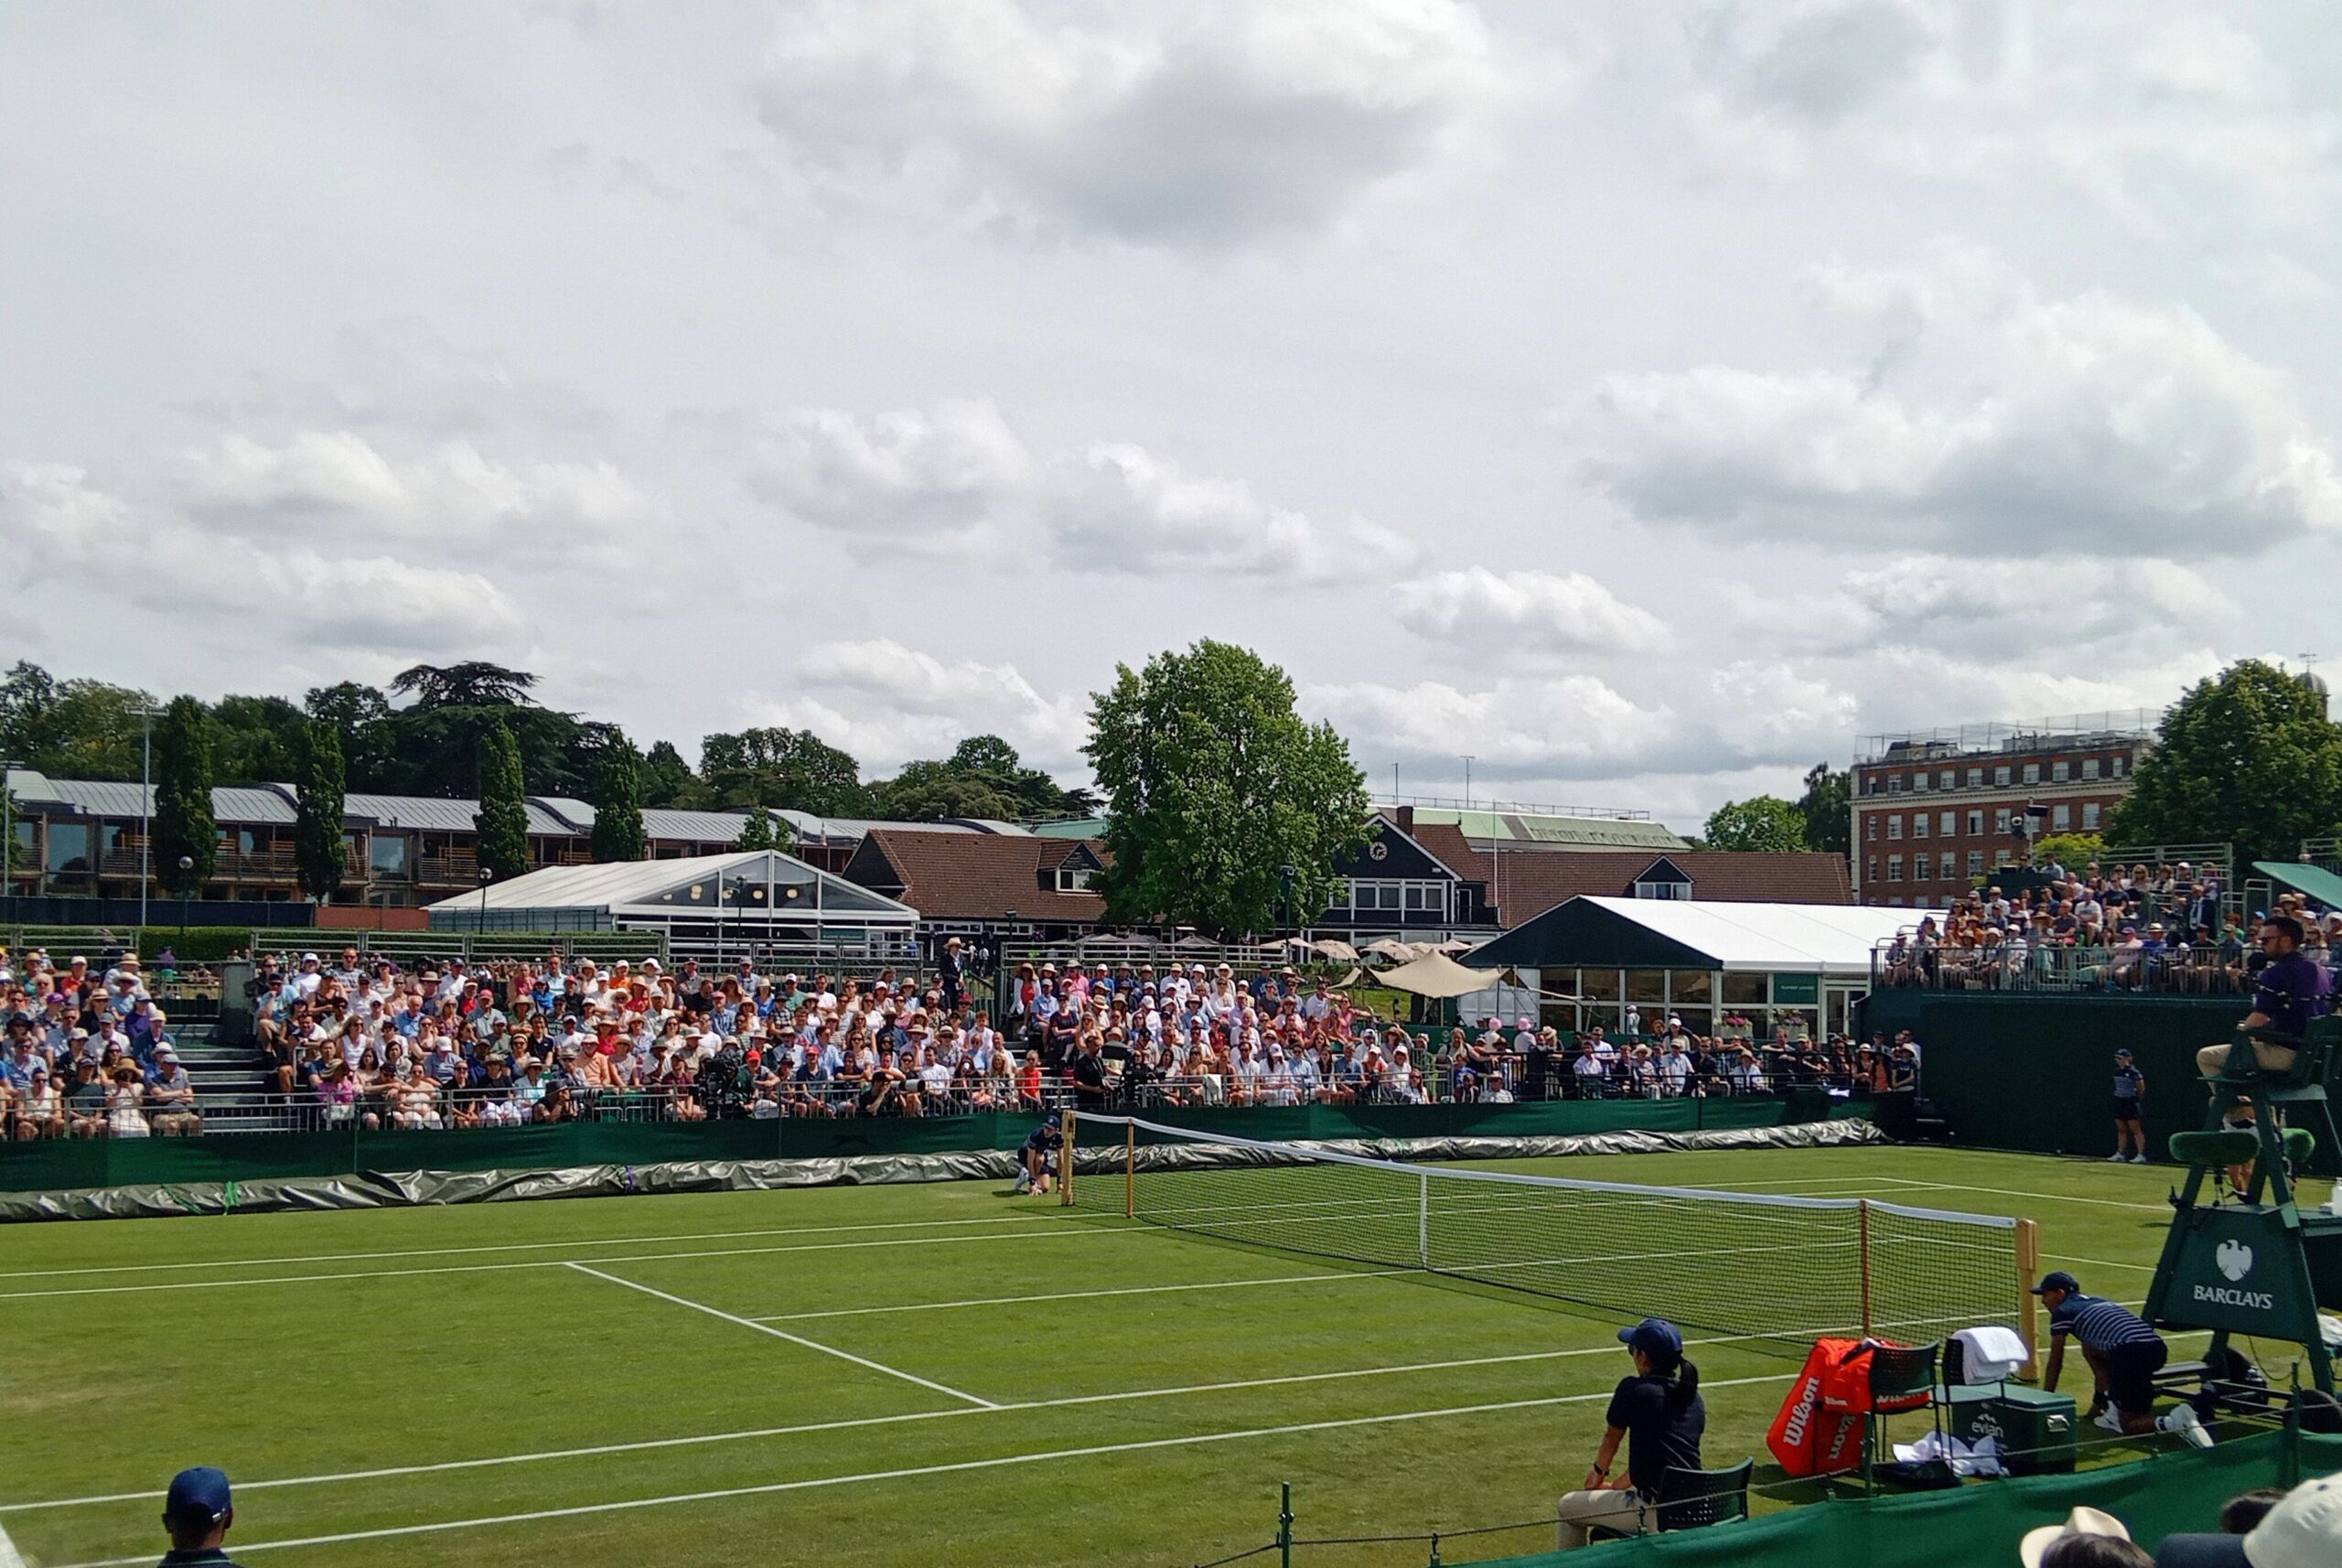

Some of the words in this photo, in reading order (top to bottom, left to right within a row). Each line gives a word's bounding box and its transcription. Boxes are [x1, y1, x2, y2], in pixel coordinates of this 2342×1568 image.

[2194, 1284, 2273, 1309] BARCLAYS
[1783, 1377, 1820, 1446] Wilson
[1971, 1422, 2004, 1437] evian
